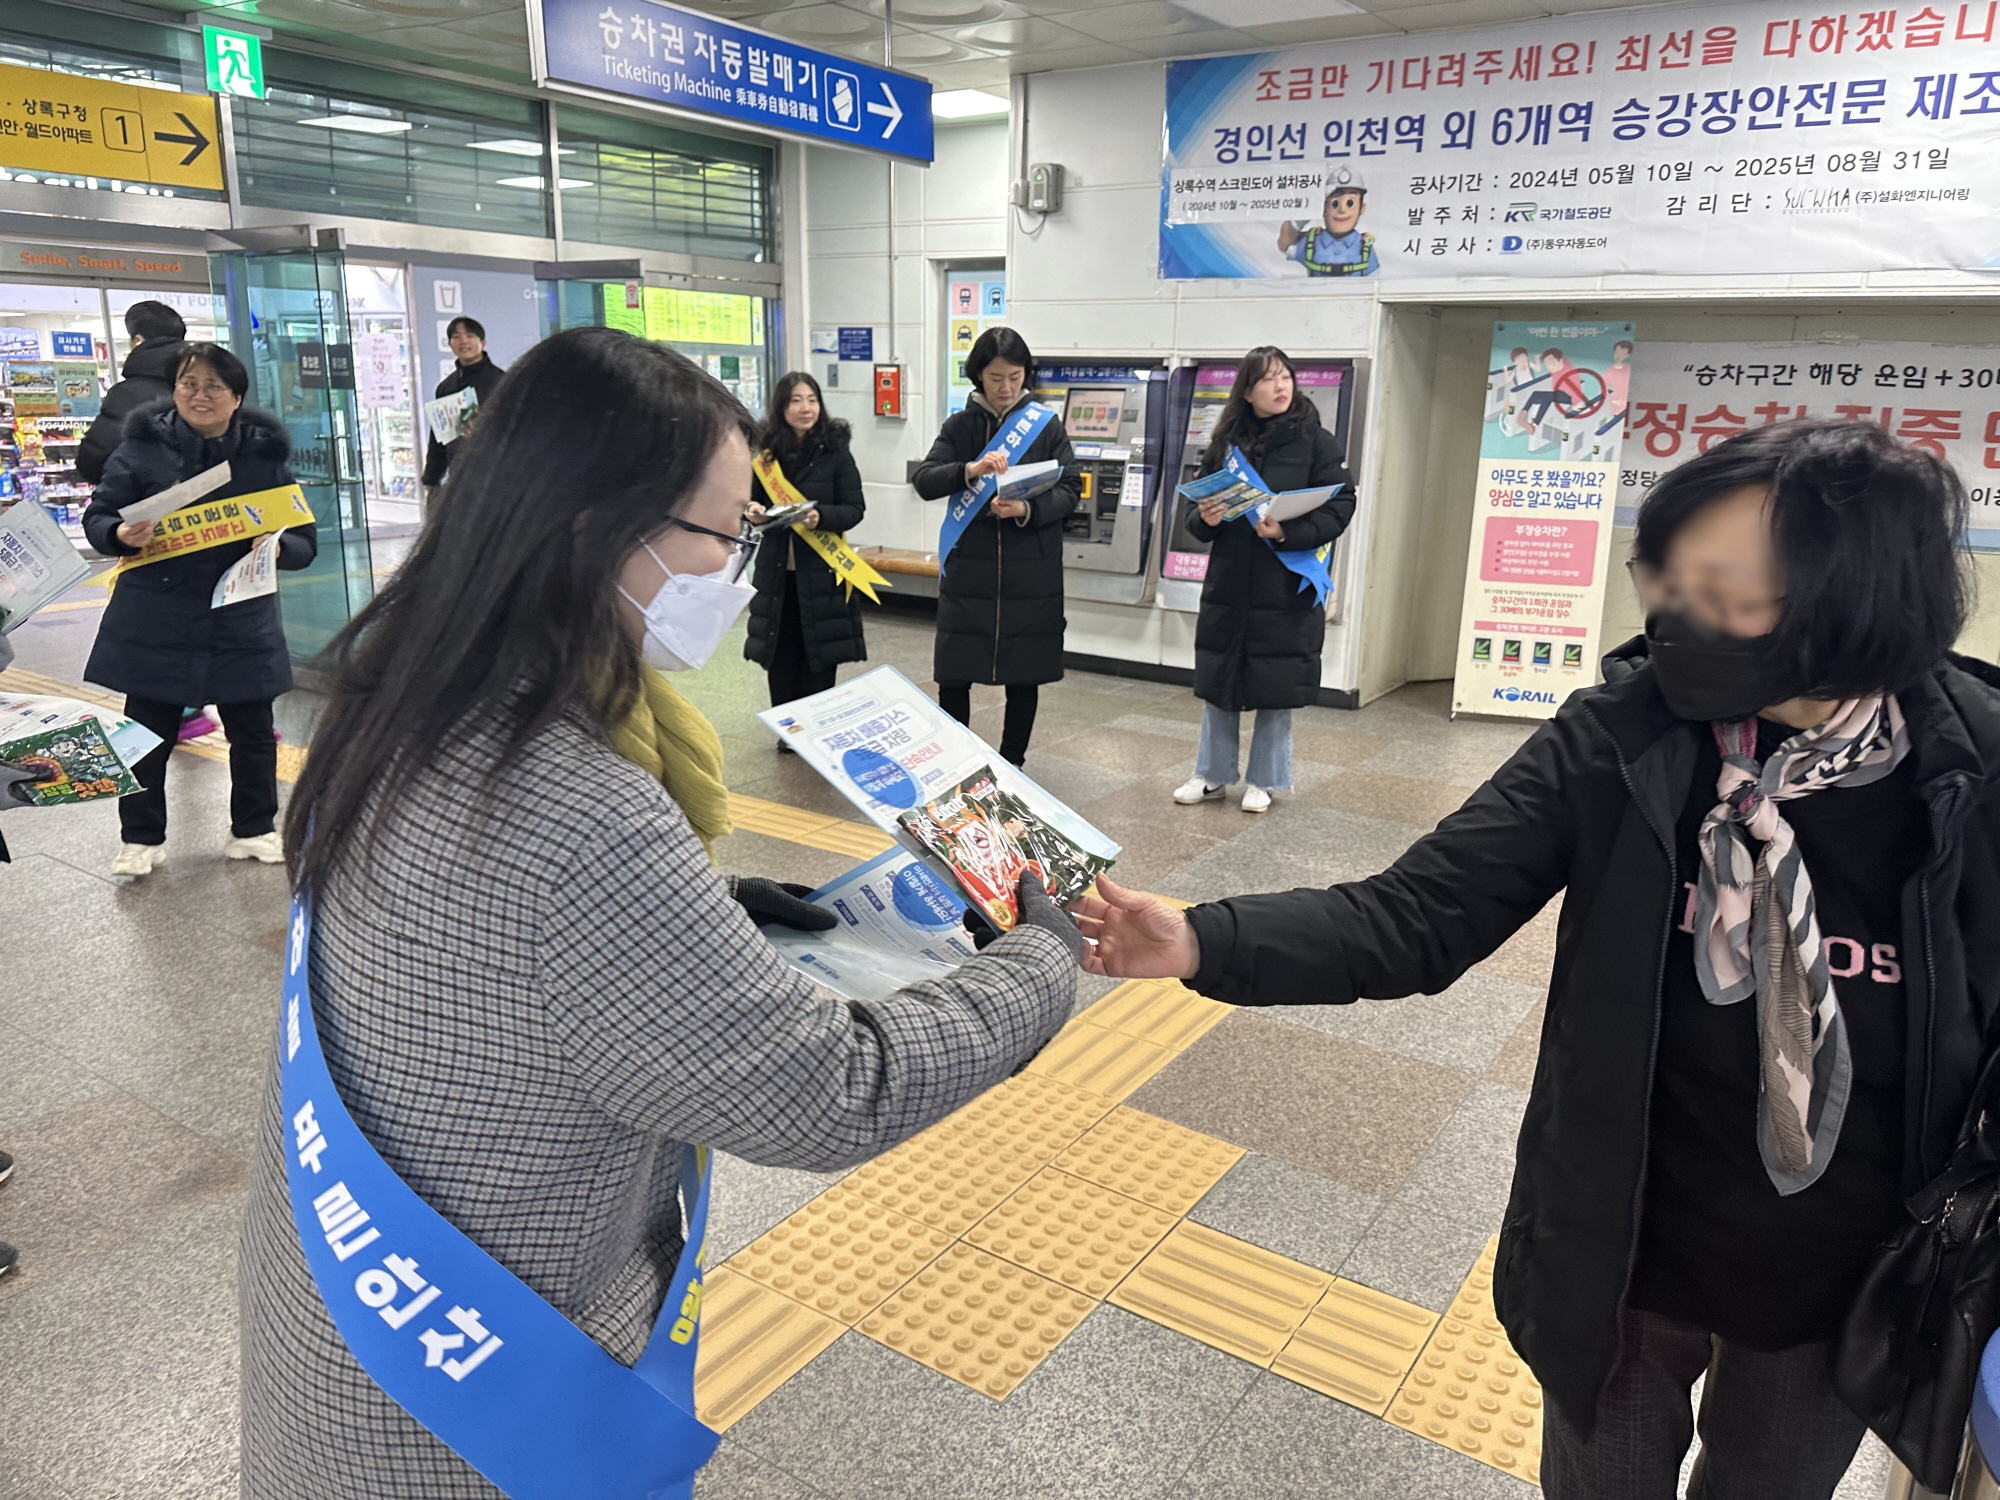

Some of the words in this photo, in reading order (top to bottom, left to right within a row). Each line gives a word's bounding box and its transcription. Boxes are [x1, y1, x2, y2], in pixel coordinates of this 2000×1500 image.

[598, 6, 686, 65] 승차권
[694, 29, 818, 99] 자동발매기
[1255, 64, 1349, 102] 조금만
[1366, 40, 1597, 94] 기다려주세요!
[1615, 26, 1738, 72] 최선을
[601, 54, 671, 93] Ticketing
[674, 73, 732, 104] Machine
[21, 96, 88, 123] 상록구청
[115, 116, 129, 145] 1
[1213, 122, 1308, 164] 경인선
[1323, 113, 1427, 159] 인천역
[1440, 110, 1477, 150] 외
[1491, 100, 1594, 146] 6개역
[1611, 78, 1887, 141] 승강장안전문
[1409, 174, 1482, 195] 공사기간
[1509, 166, 1578, 189] 2024년
[1588, 163, 1635, 186] 05월
[1646, 160, 1693, 183] 10일
[1734, 153, 1815, 178] 2025년
[1827, 150, 1882, 174] 08월
[1894, 147, 1950, 170] 31일
[1174, 177, 1216, 194] 상록수역
[1218, 175, 1273, 191] 스크린도어
[1276, 173, 1321, 190] 설치공사
[1219, 199, 1237, 211] 10월
[1250, 198, 1279, 210] 2025년
[1855, 187, 1971, 206] (주)설화엔지니어링
[1539, 206, 1611, 221] 국가철도공단
[1526, 236, 1607, 252] (주)동우자동도어
[19, 251, 72, 268] Smile,
[78, 255, 130, 271] Smart,
[135, 259, 182, 273] Speed
[1809, 362, 1863, 386] 해당
[1491, 468, 1528, 485] 아무도
[1531, 470, 1544, 487] 못
[1547, 470, 1606, 489] 봤을까요?
[1489, 489, 1525, 508] 양심은
[1527, 491, 1551, 508] 알고
[1553, 492, 1603, 510] 있습니다
[1515, 524, 1568, 538] 부정승차란?
